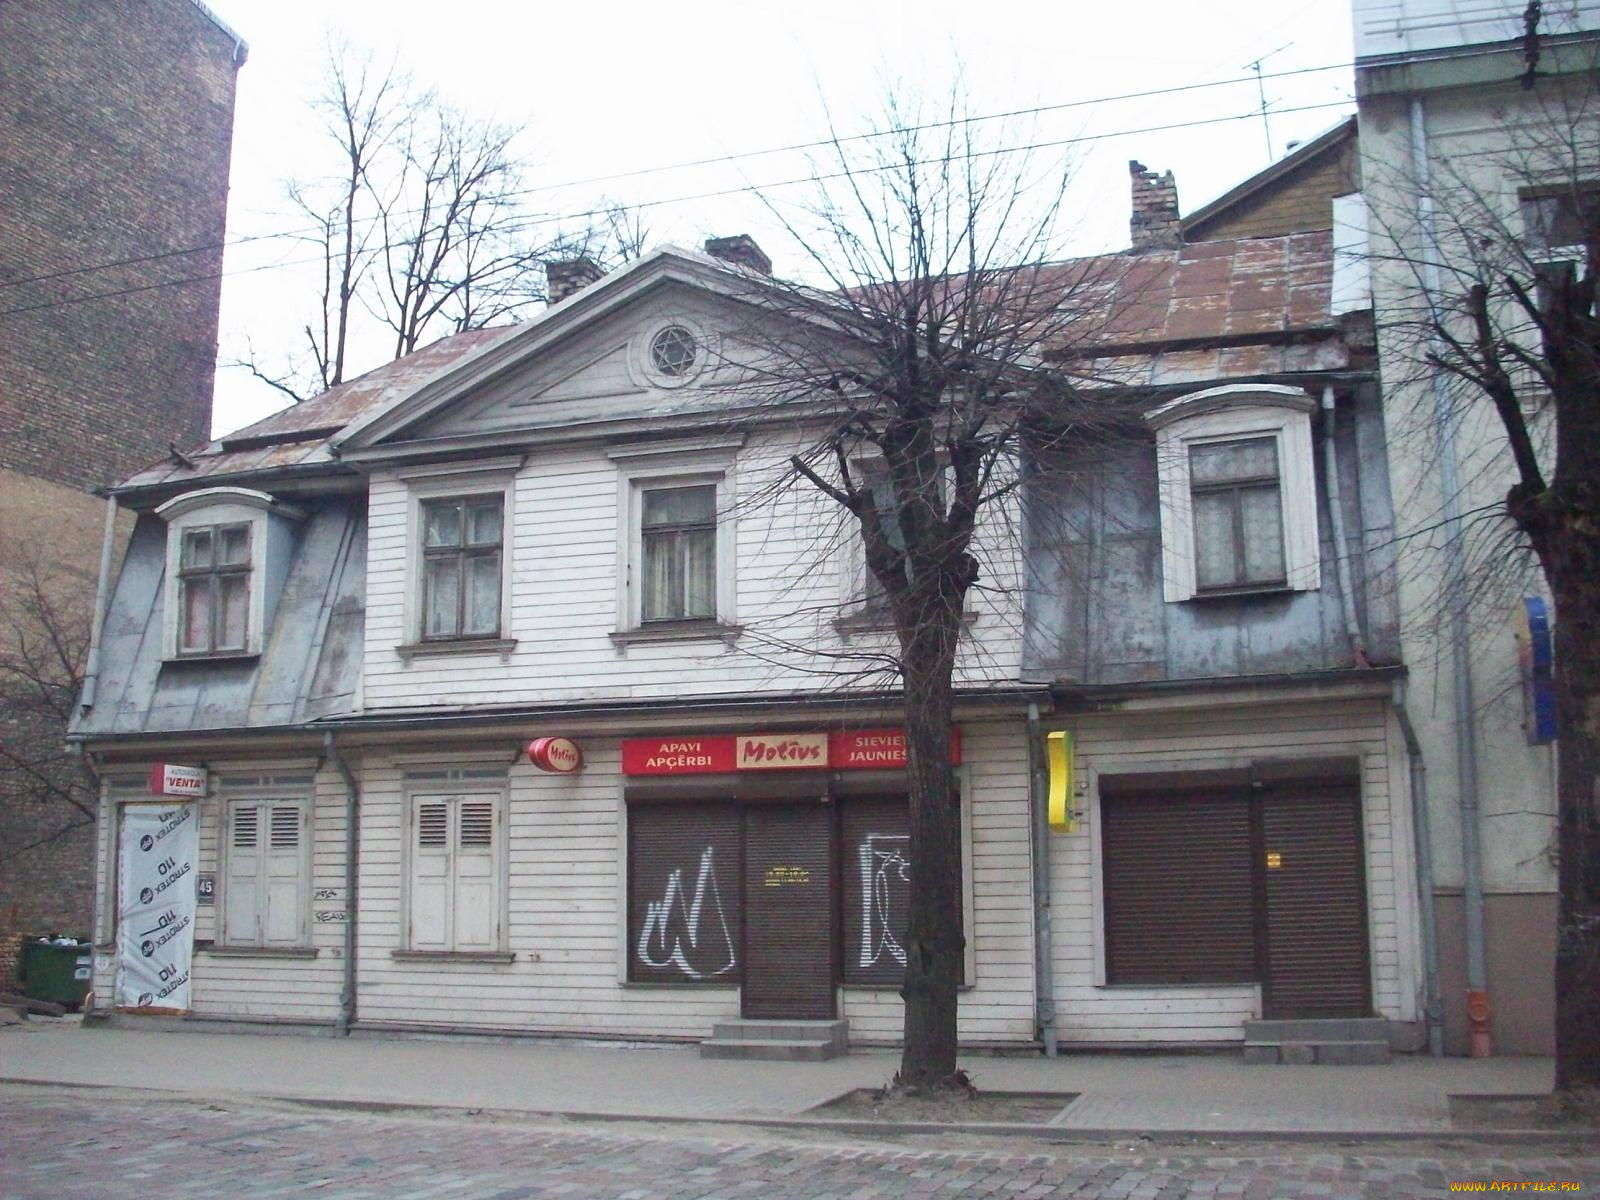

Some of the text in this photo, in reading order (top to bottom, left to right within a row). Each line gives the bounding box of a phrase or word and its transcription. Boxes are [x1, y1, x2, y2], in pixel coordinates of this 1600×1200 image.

[659, 742, 701, 753] APAVI
[166, 777, 206, 789] "VENTA"
[155, 808, 191, 841] STROTEX
[157, 856, 176, 877] 110
[155, 862, 191, 895] STROTEX
[199, 880, 212, 893] 45
[158, 909, 176, 929] 110
[155, 915, 190, 948] STROTEX
[159, 963, 177, 982] 110
